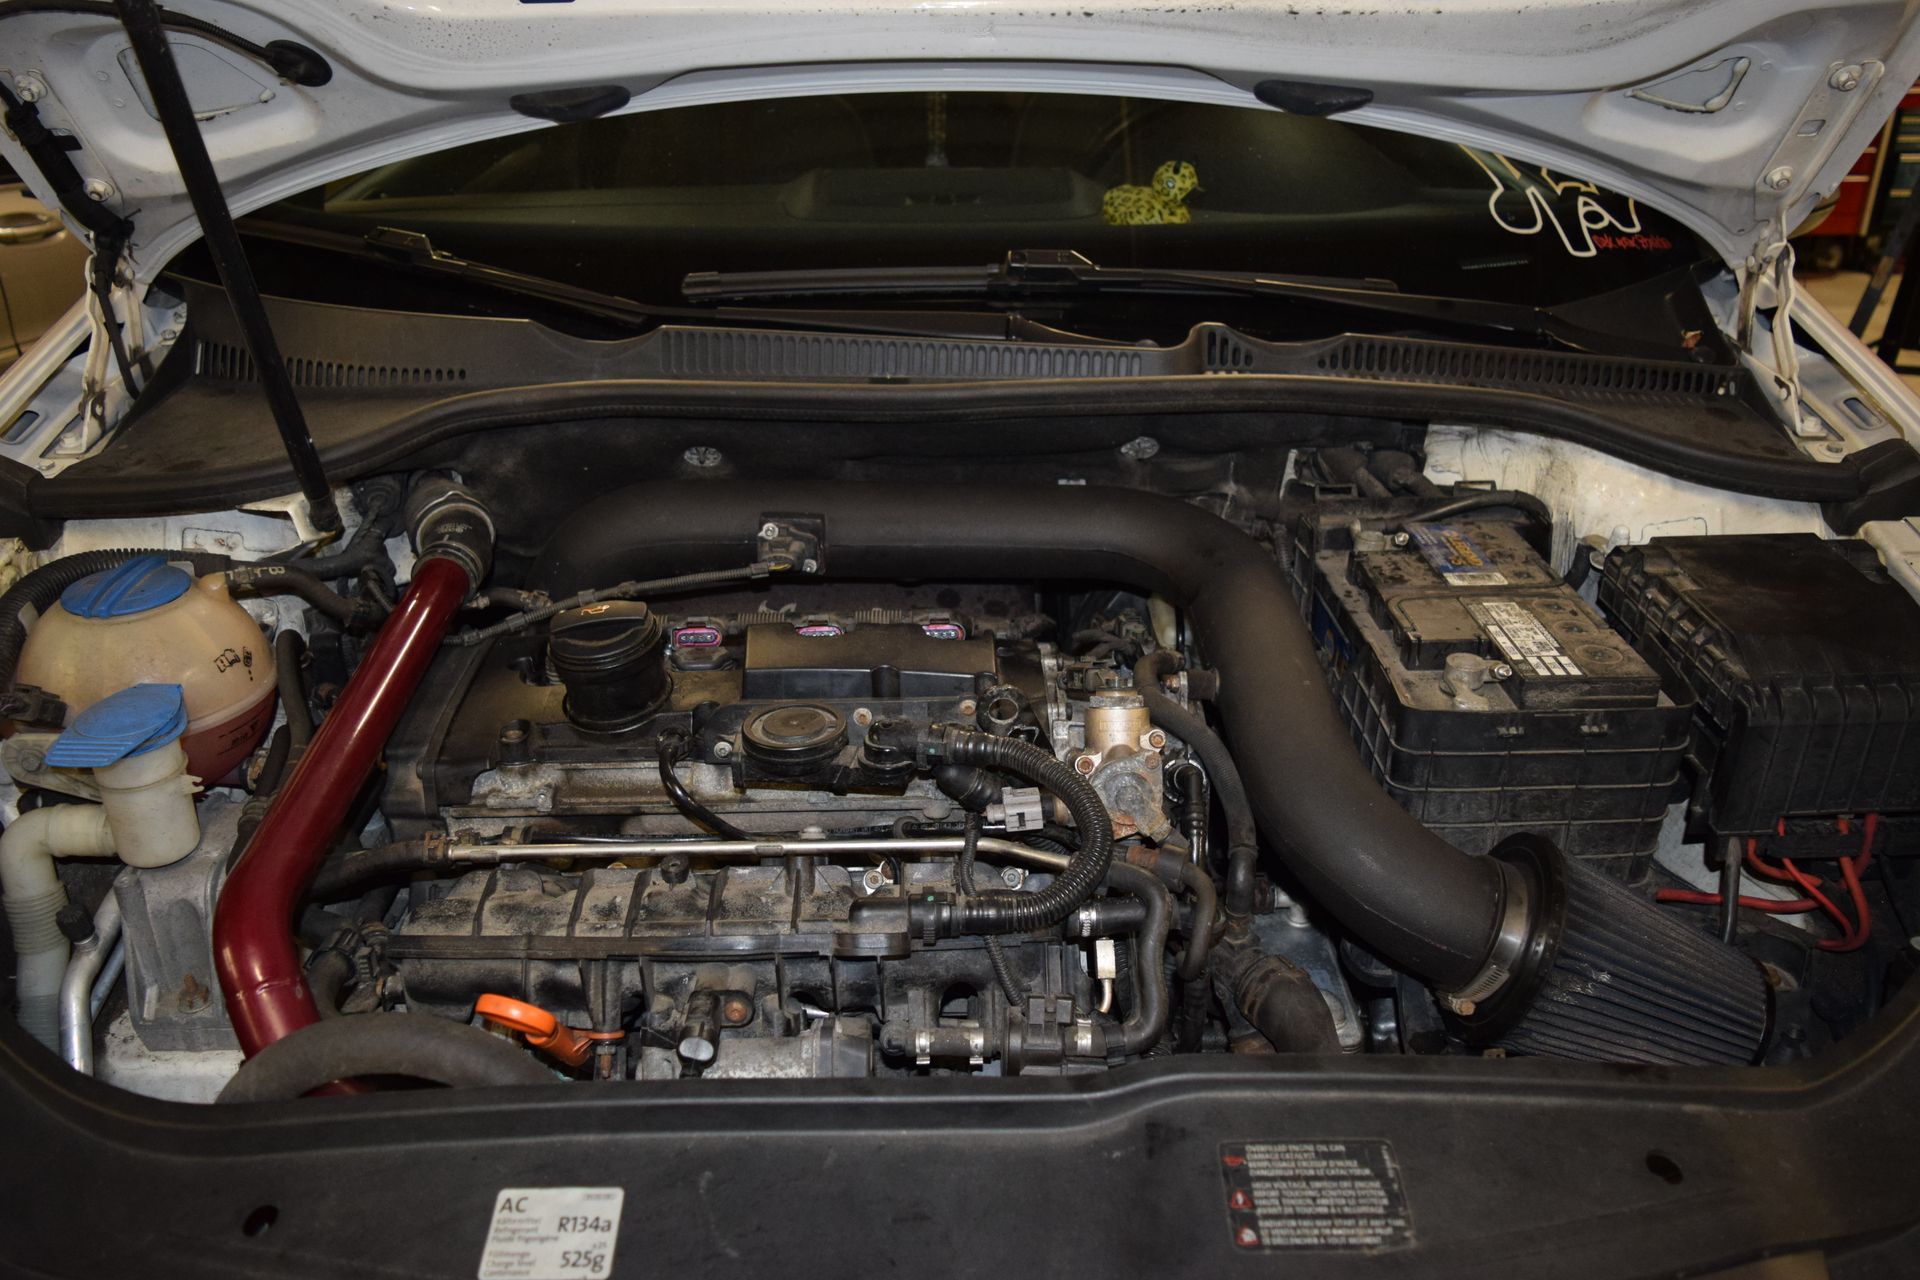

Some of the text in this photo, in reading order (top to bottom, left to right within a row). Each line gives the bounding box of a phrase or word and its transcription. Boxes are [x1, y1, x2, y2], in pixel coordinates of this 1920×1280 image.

[500, 1197, 529, 1214] AC
[558, 1216, 612, 1233] R134a
[560, 1250, 606, 1273] 525g
